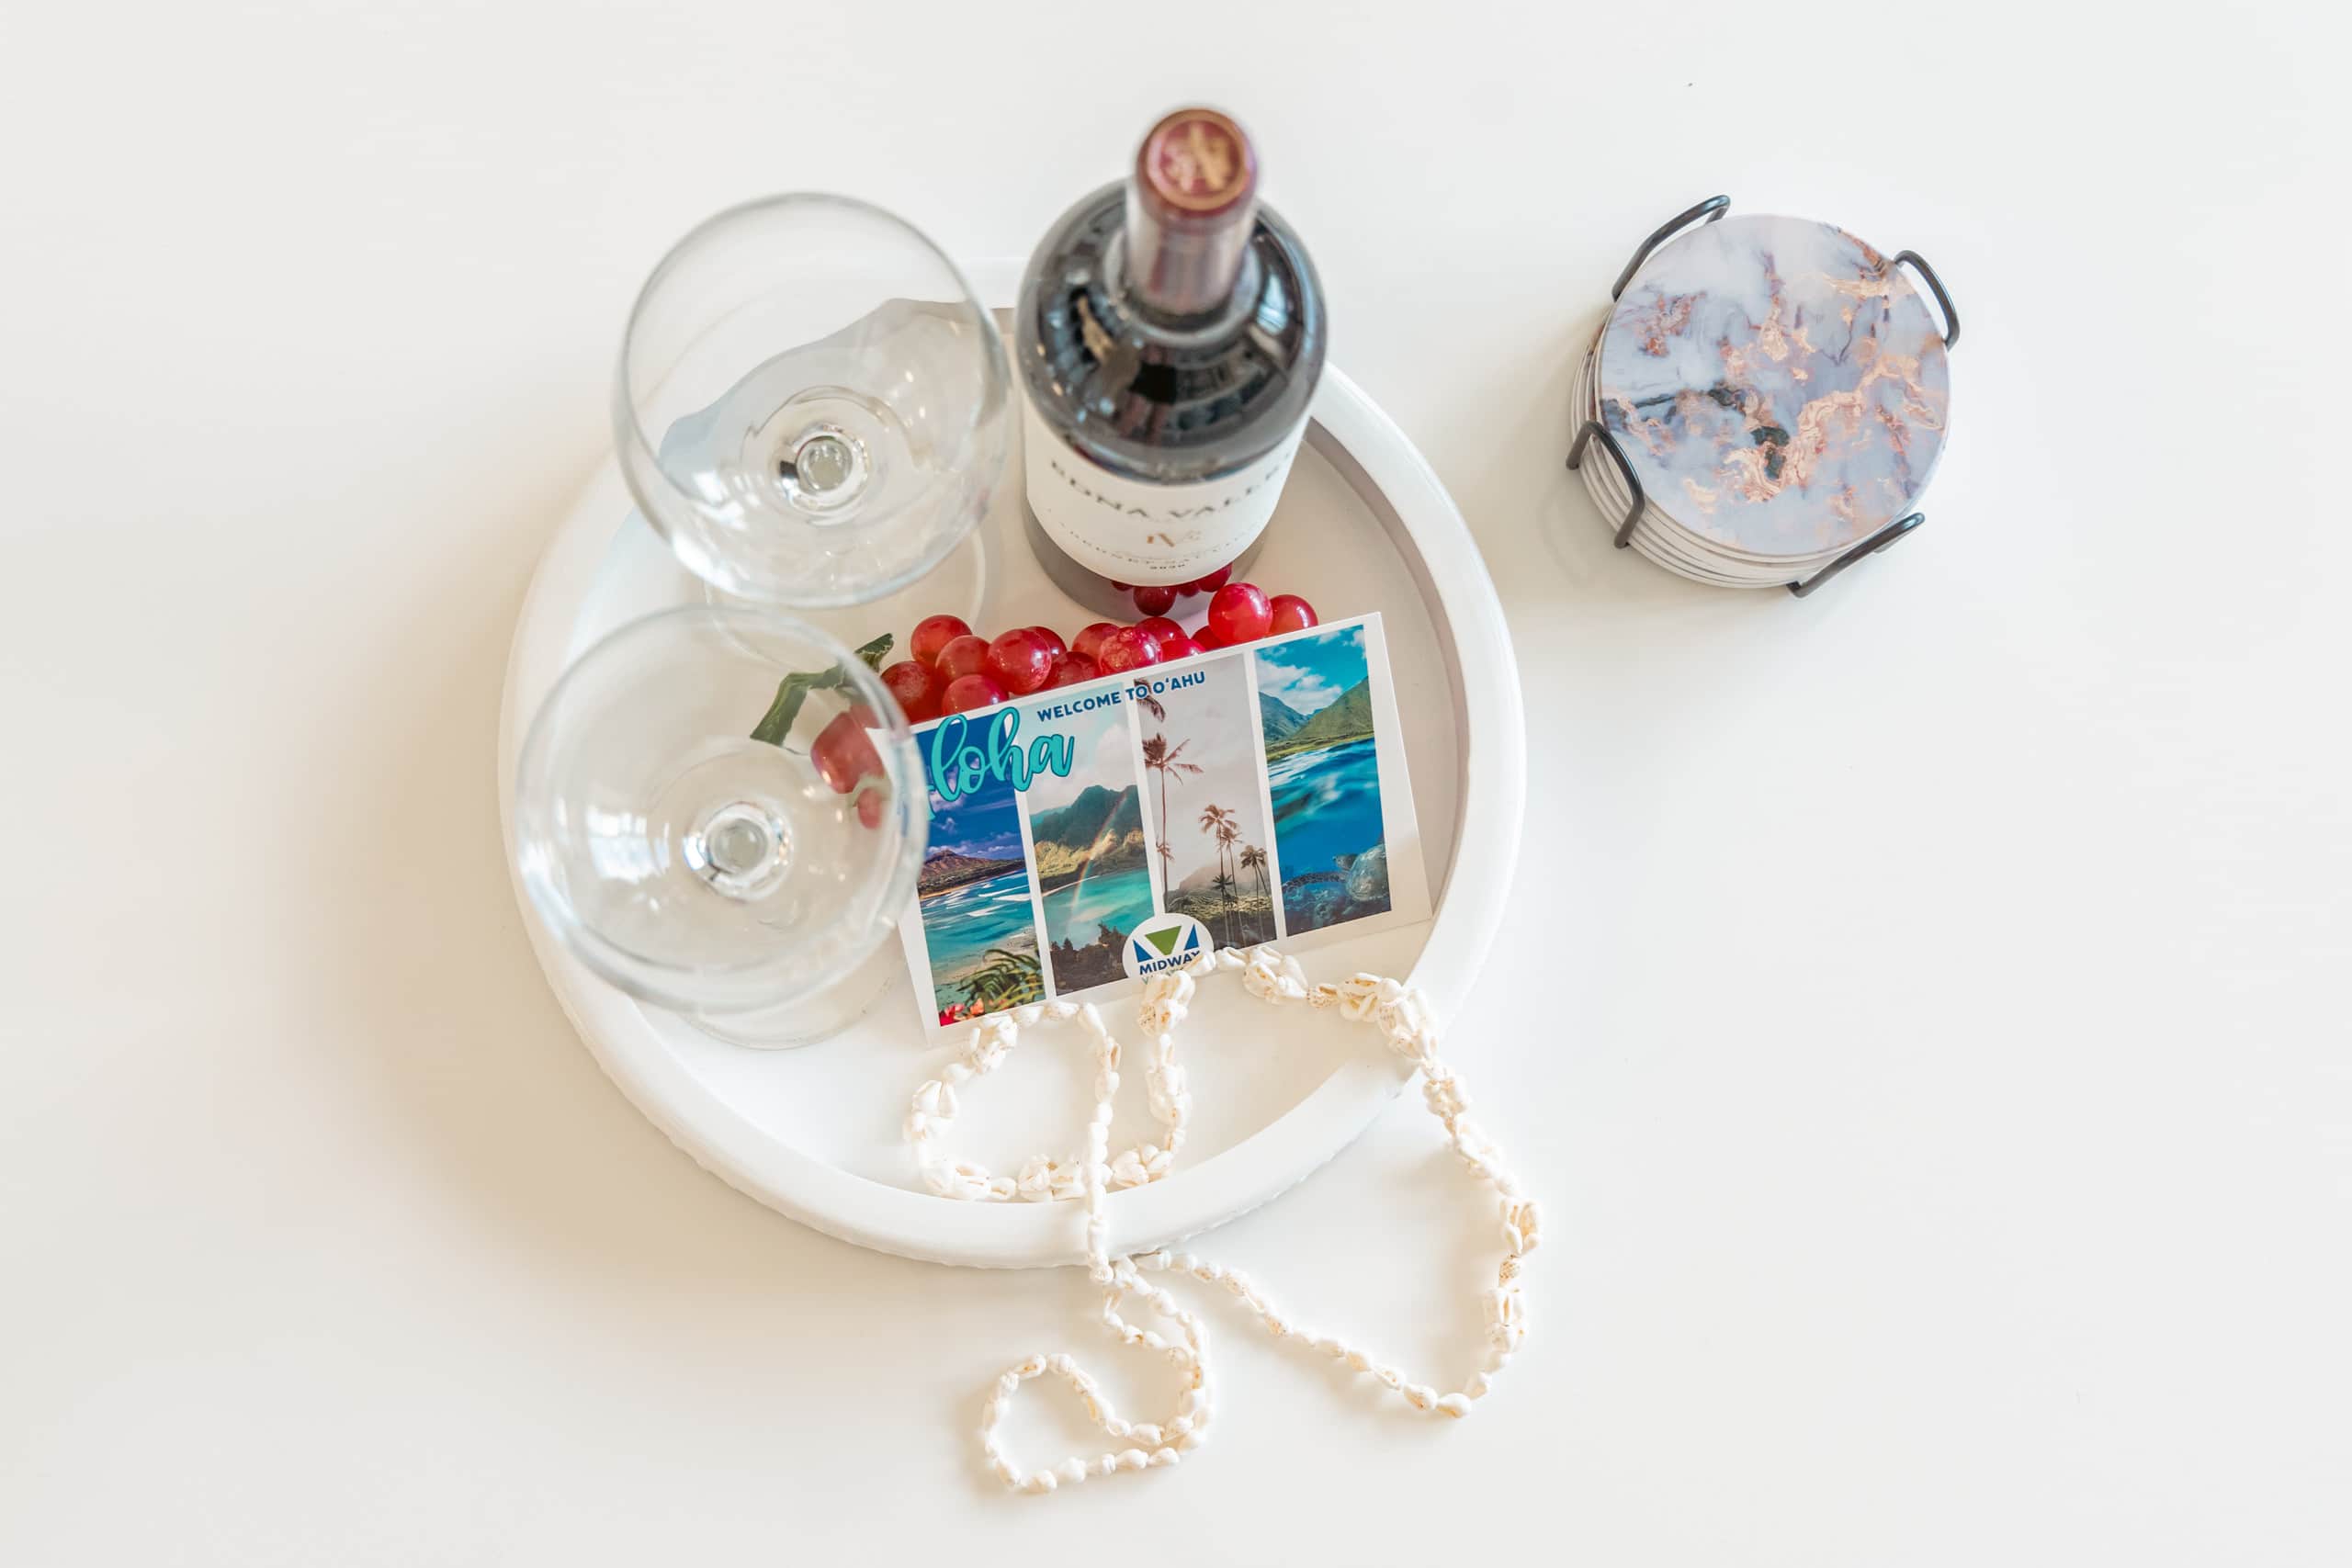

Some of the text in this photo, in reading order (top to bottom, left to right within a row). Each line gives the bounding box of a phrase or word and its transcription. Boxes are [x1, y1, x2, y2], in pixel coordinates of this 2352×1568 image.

[1036, 691, 1122, 722] WELCOME
[1125, 686, 1148, 701] TO
[927, 706, 1075, 818] loha
[1139, 950, 1201, 976] MIDWAY
